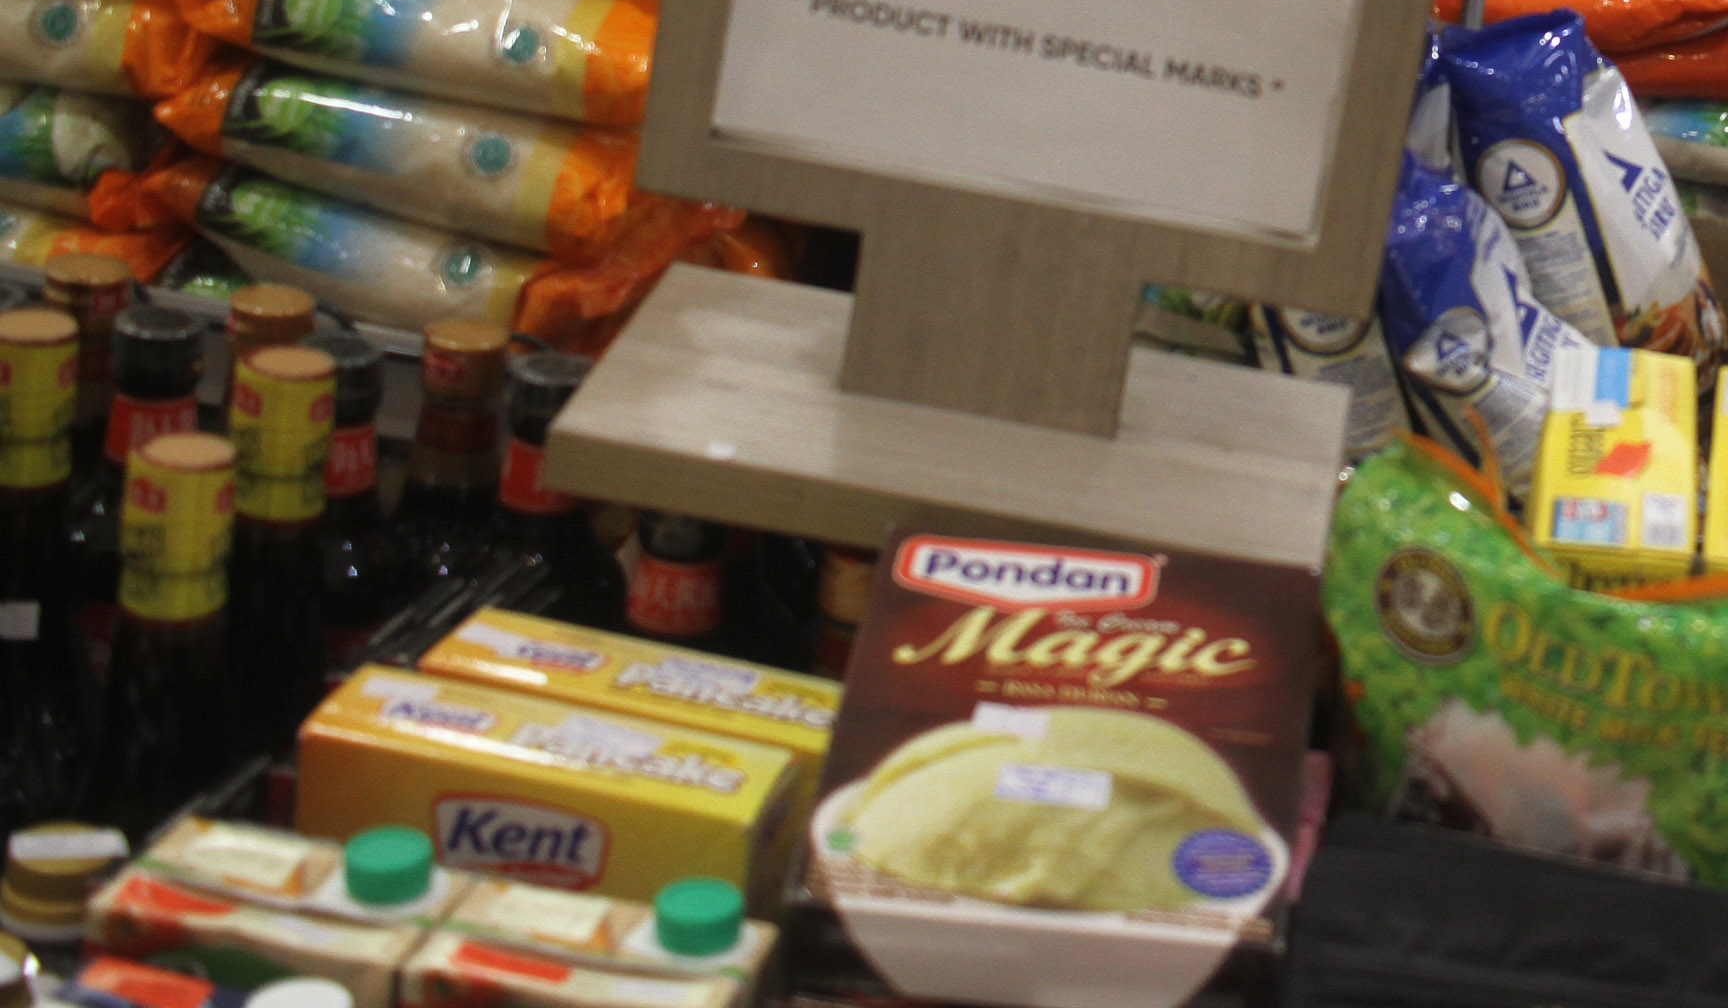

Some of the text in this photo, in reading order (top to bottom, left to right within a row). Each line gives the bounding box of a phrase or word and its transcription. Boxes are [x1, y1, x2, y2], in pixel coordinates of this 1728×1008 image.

[958, 17, 1034, 55] WITH
[1040, 34, 1156, 80] SPECIAL
[1161, 58, 1264, 99] MARKS
[925, 548, 1131, 593] Pondan
[891, 605, 1260, 689] Magic
[446, 797, 591, 864] Kent
